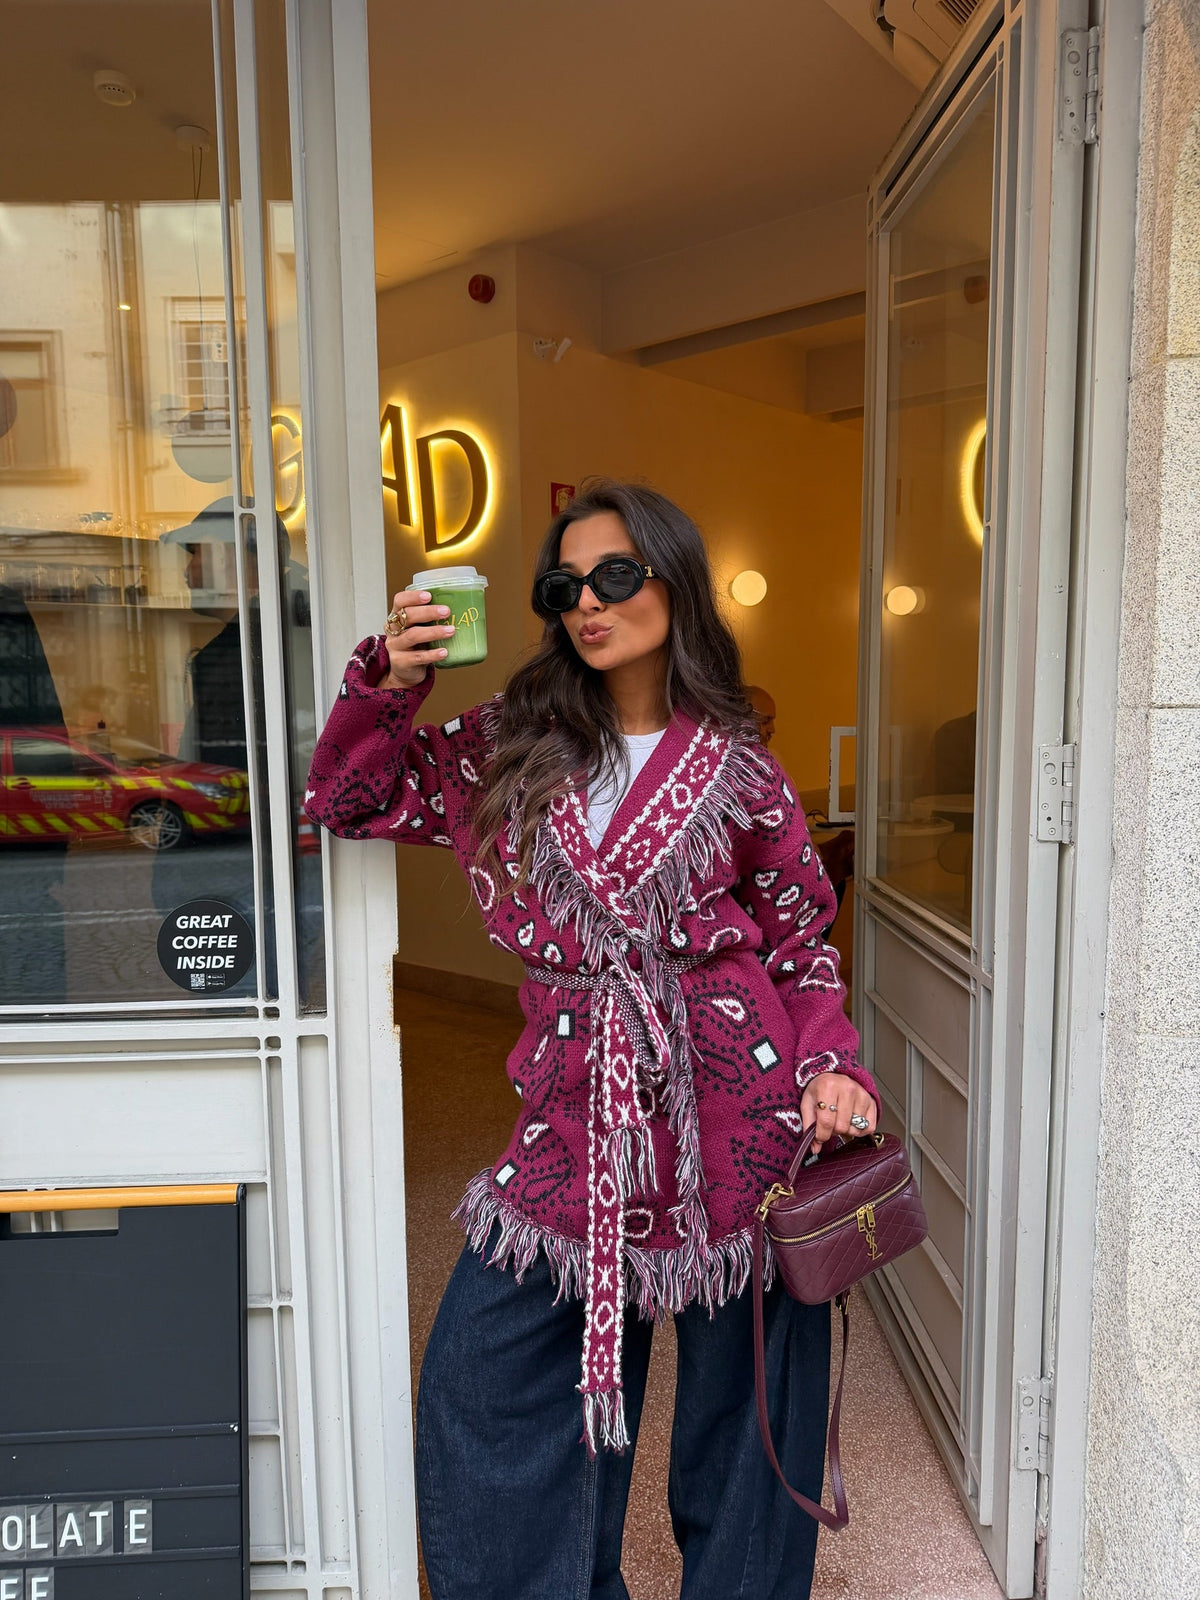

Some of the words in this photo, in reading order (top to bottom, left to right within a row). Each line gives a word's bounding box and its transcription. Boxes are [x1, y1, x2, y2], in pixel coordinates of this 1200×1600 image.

[176, 914, 233, 930] GREAT
[172, 935, 238, 950] COFFEE
[176, 955, 236, 970] INSIDE
